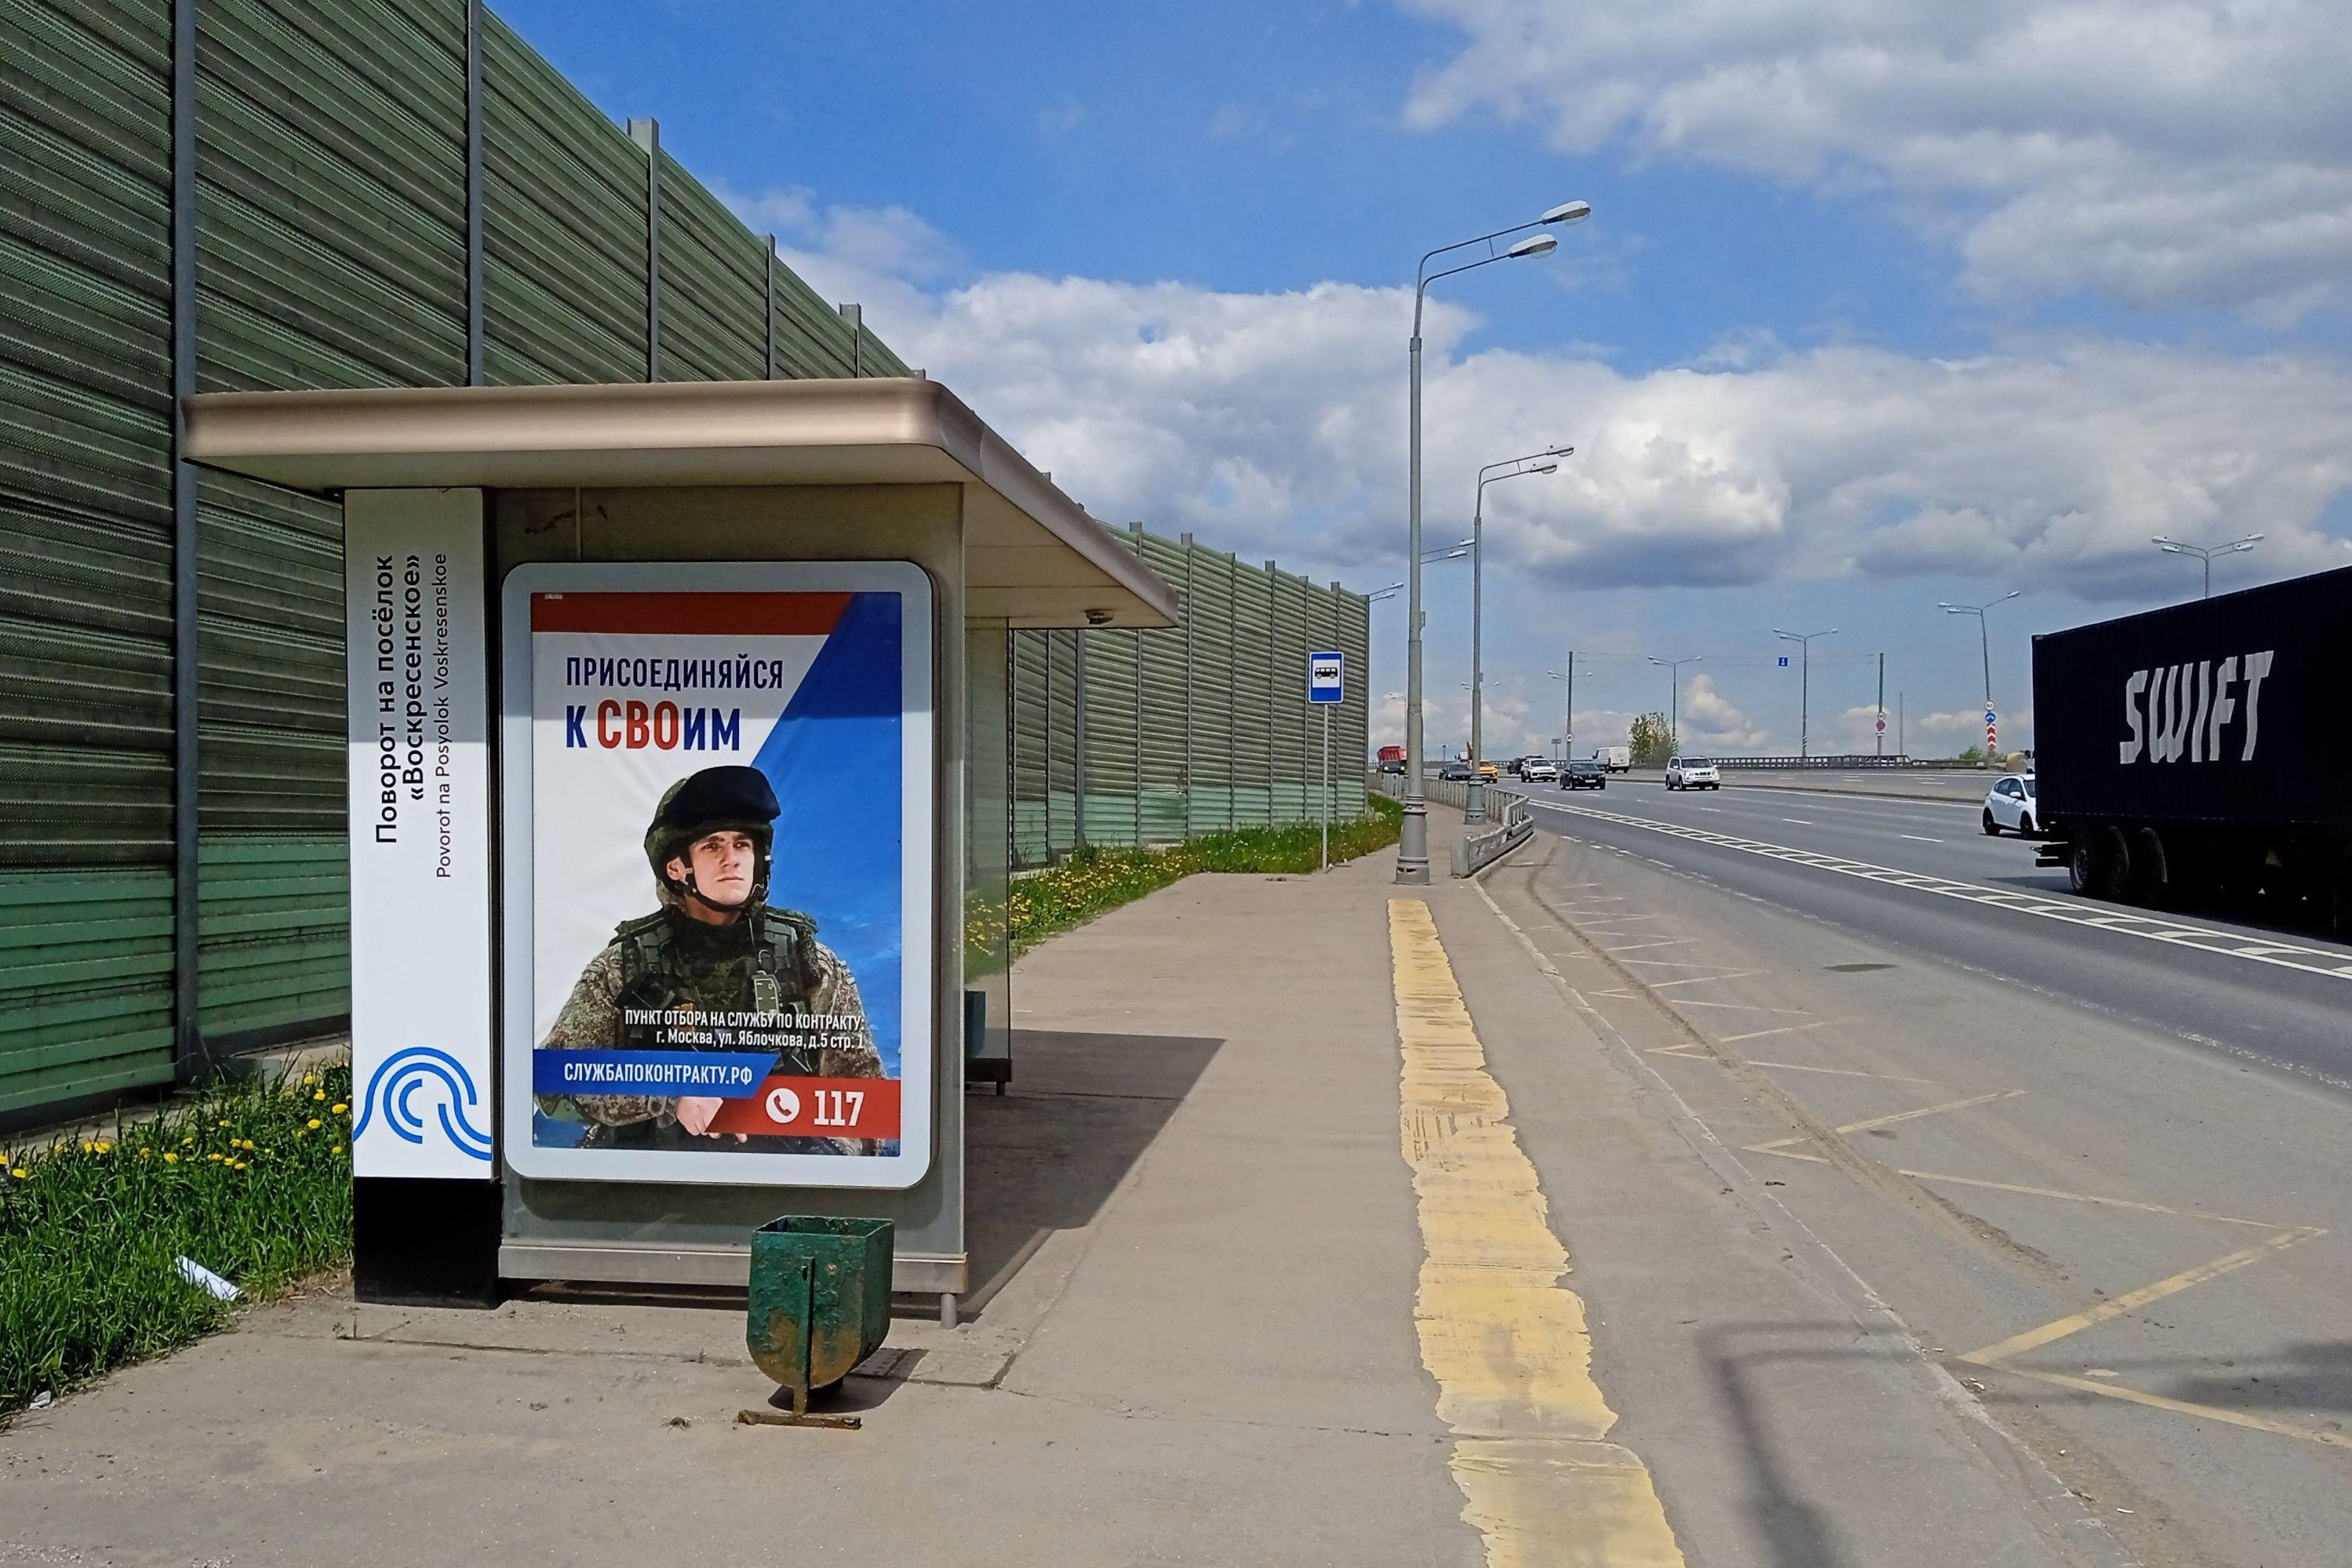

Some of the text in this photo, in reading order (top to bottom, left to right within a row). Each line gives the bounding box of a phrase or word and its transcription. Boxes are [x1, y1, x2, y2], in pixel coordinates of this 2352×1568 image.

[402, 554, 428, 800] «Воскресенское»
[566, 653, 784, 692] ПРИСОЕДИНЯЙСЯ
[372, 555, 401, 842] Поворот на посёлок
[431, 553, 453, 878] Povorot na Posyolok Voskresenskoe
[2120, 650, 2274, 765] SWIFT
[566, 699, 741, 751] К СВОИМ
[624, 1010, 865, 1031] ПУНКТ ОТБОРА НА СЛУЖБУ ПО КОНТРАКТУ:
[656, 1031, 665, 1043] г.
[668, 1028, 716, 1047] Москва,
[718, 1032, 736, 1048] ул.
[737, 1030, 806, 1050] Яблочкова,
[830, 1035, 855, 1052] стр.
[857, 1034, 864, 1049] 1
[564, 1063, 753, 1086] СЛУЖБАПОКОНТРАКТУ.РФ
[813, 1090, 865, 1127] 117
